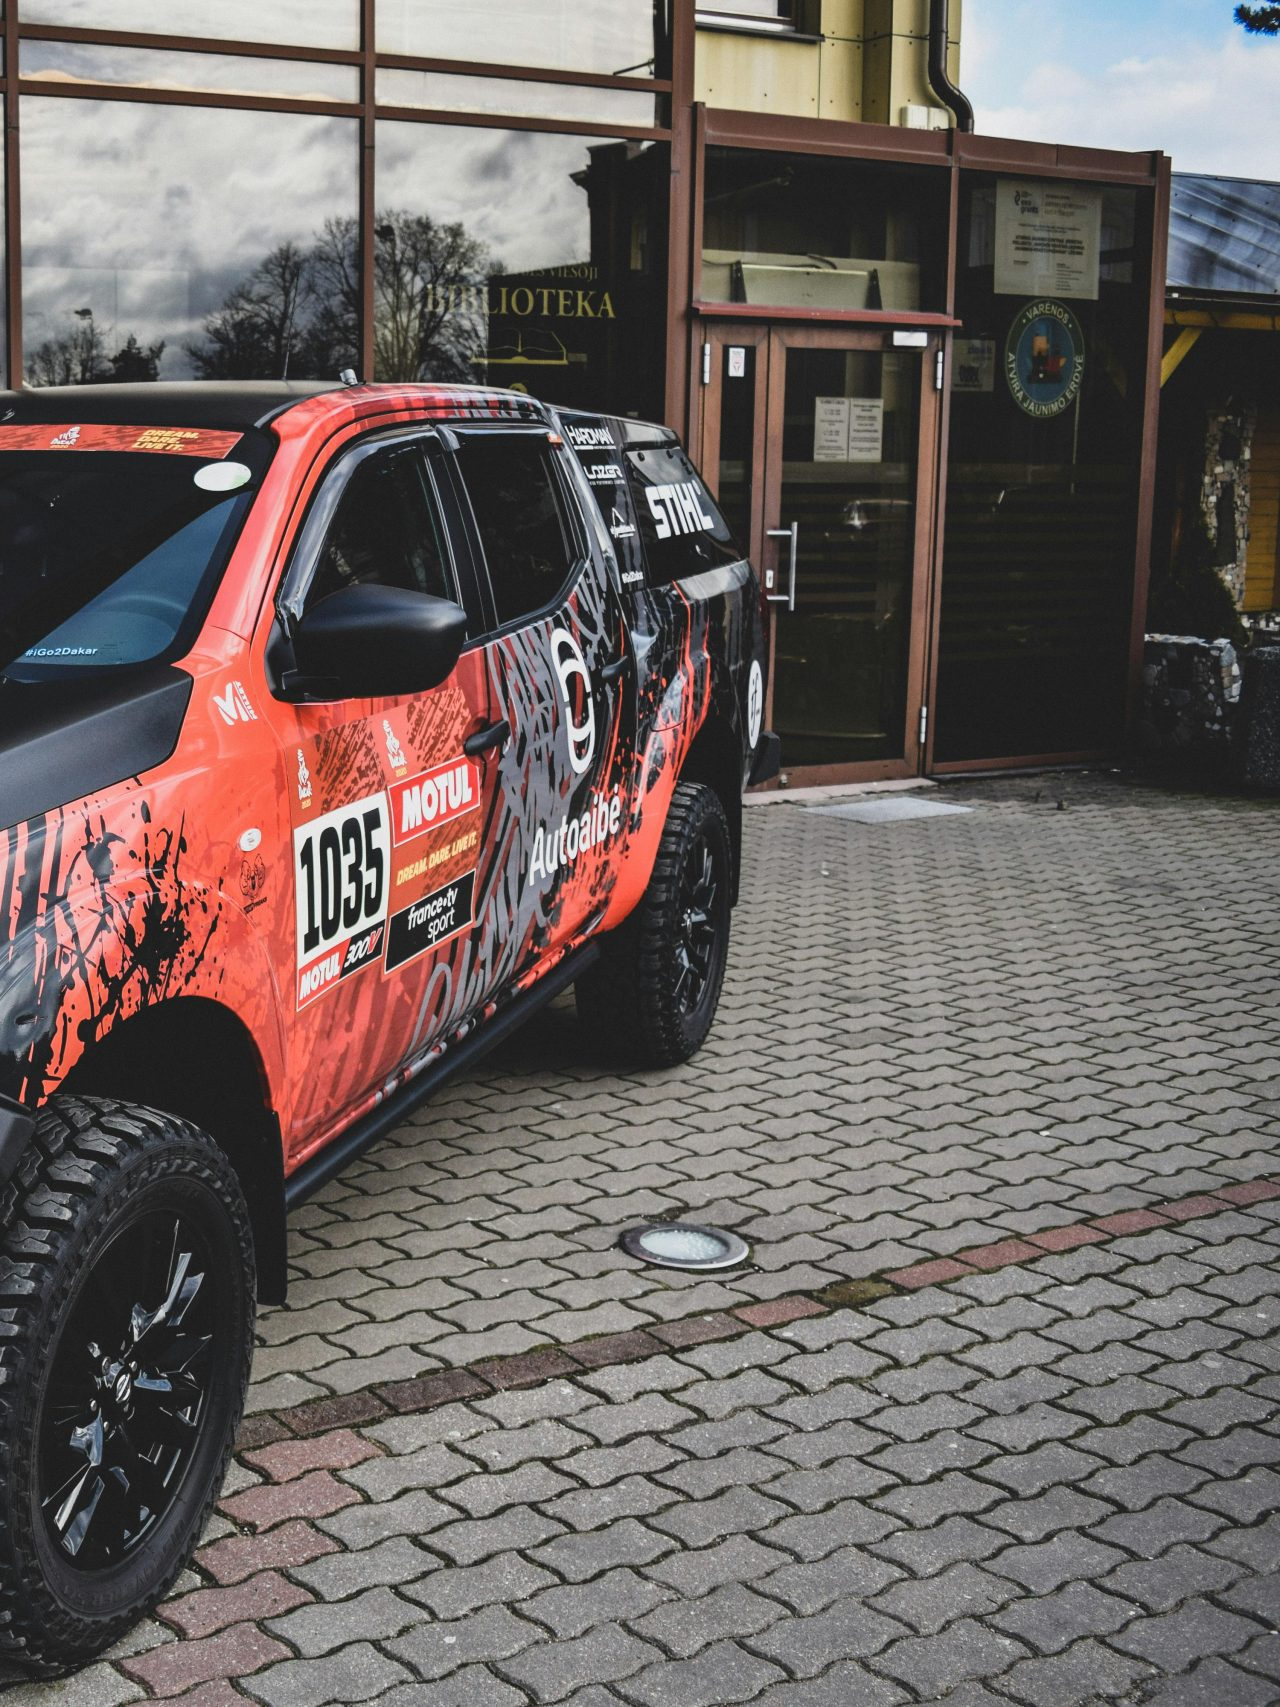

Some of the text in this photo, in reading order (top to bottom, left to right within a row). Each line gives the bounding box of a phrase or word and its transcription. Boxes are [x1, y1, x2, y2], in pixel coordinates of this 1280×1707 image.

[424, 285, 616, 318] BIBLIOTEKA
[1008, 352, 1024, 401] ATVIRA
[1023, 398, 1066, 415] JAUNIMO
[25, 647, 98, 657] #iGo2Dakar
[401, 764, 473, 834] MOTUL
[529, 783, 621, 887] Autoaibė
[300, 807, 384, 955] 1035
[396, 863, 429, 886] DREAM.
[427, 909, 455, 943] sport
[300, 927, 383, 1000] MOTUL 300V
